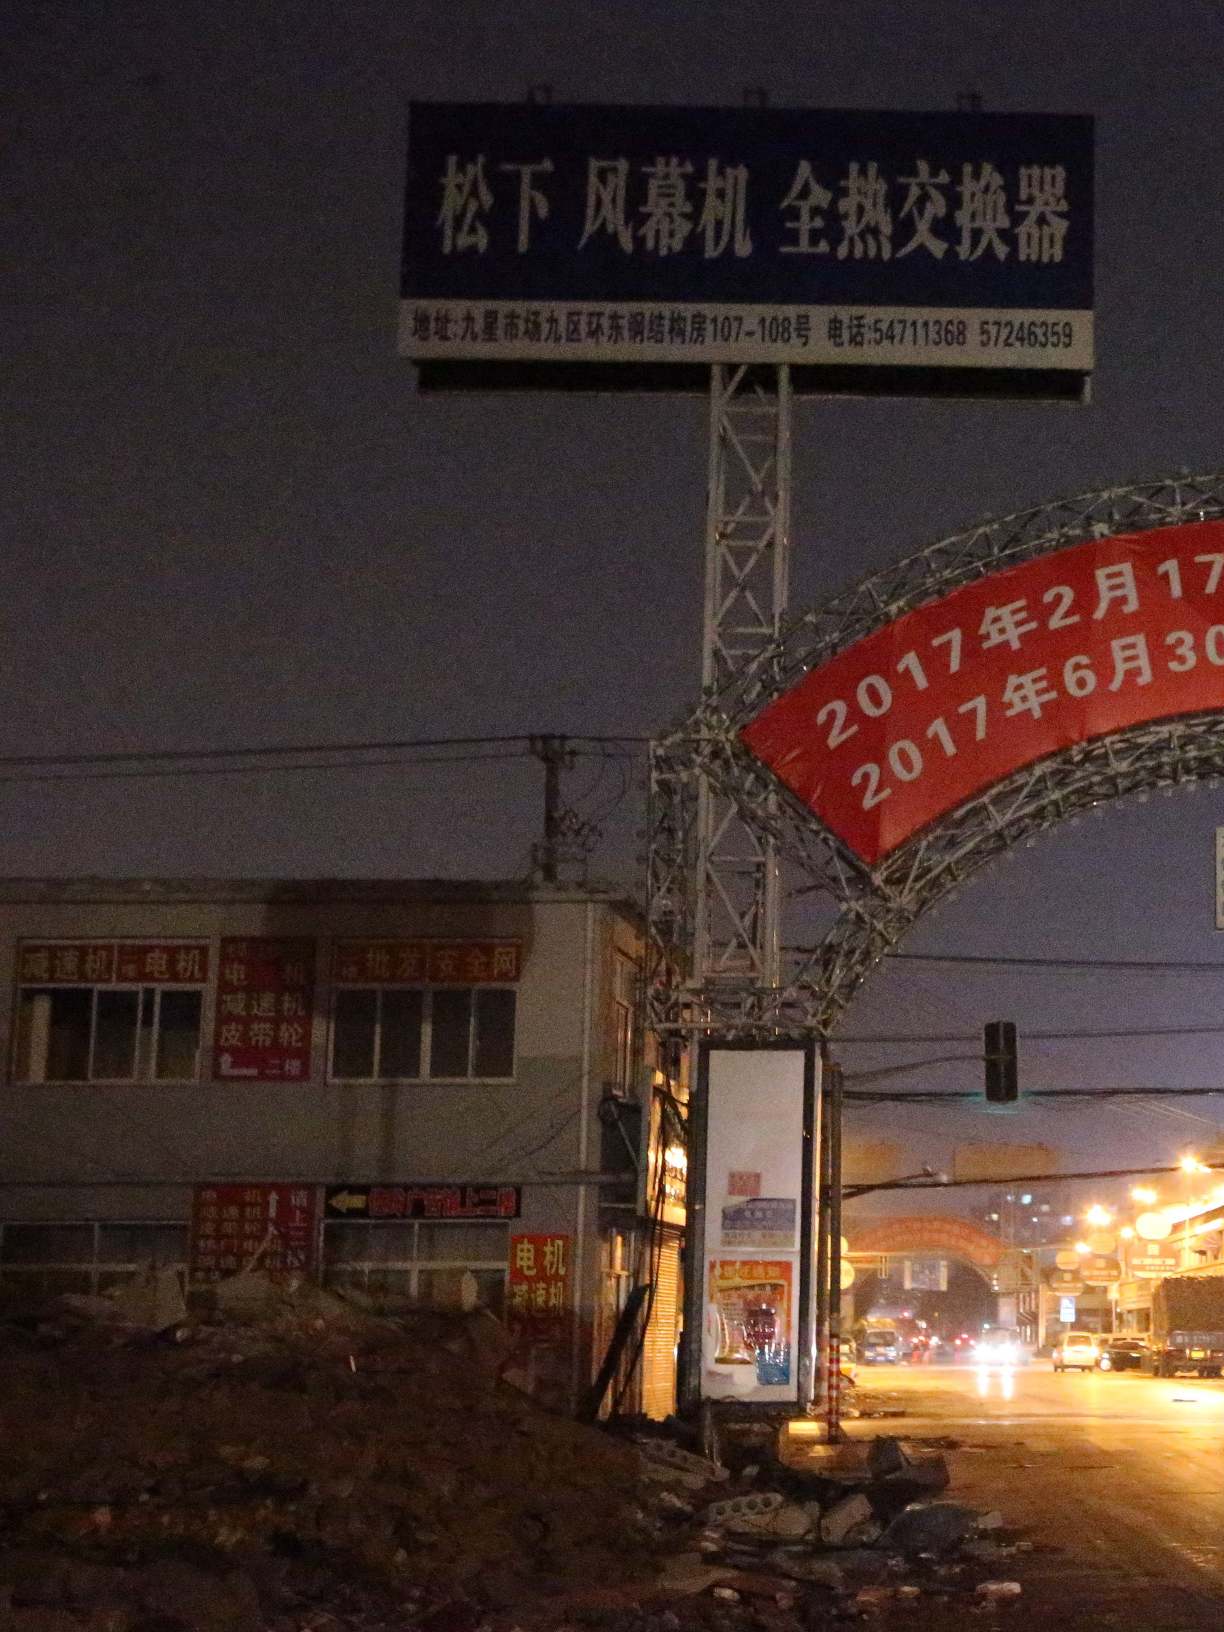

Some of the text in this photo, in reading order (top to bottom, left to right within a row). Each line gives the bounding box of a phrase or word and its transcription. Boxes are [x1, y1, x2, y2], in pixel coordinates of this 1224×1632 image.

[437, 154, 1071, 264] 松下 风幕机 全热交换器
[979, 319, 1073, 349] 57246359
[221, 1021, 304, 1048] 皮带轮
[515, 1238, 566, 1276] 电机
